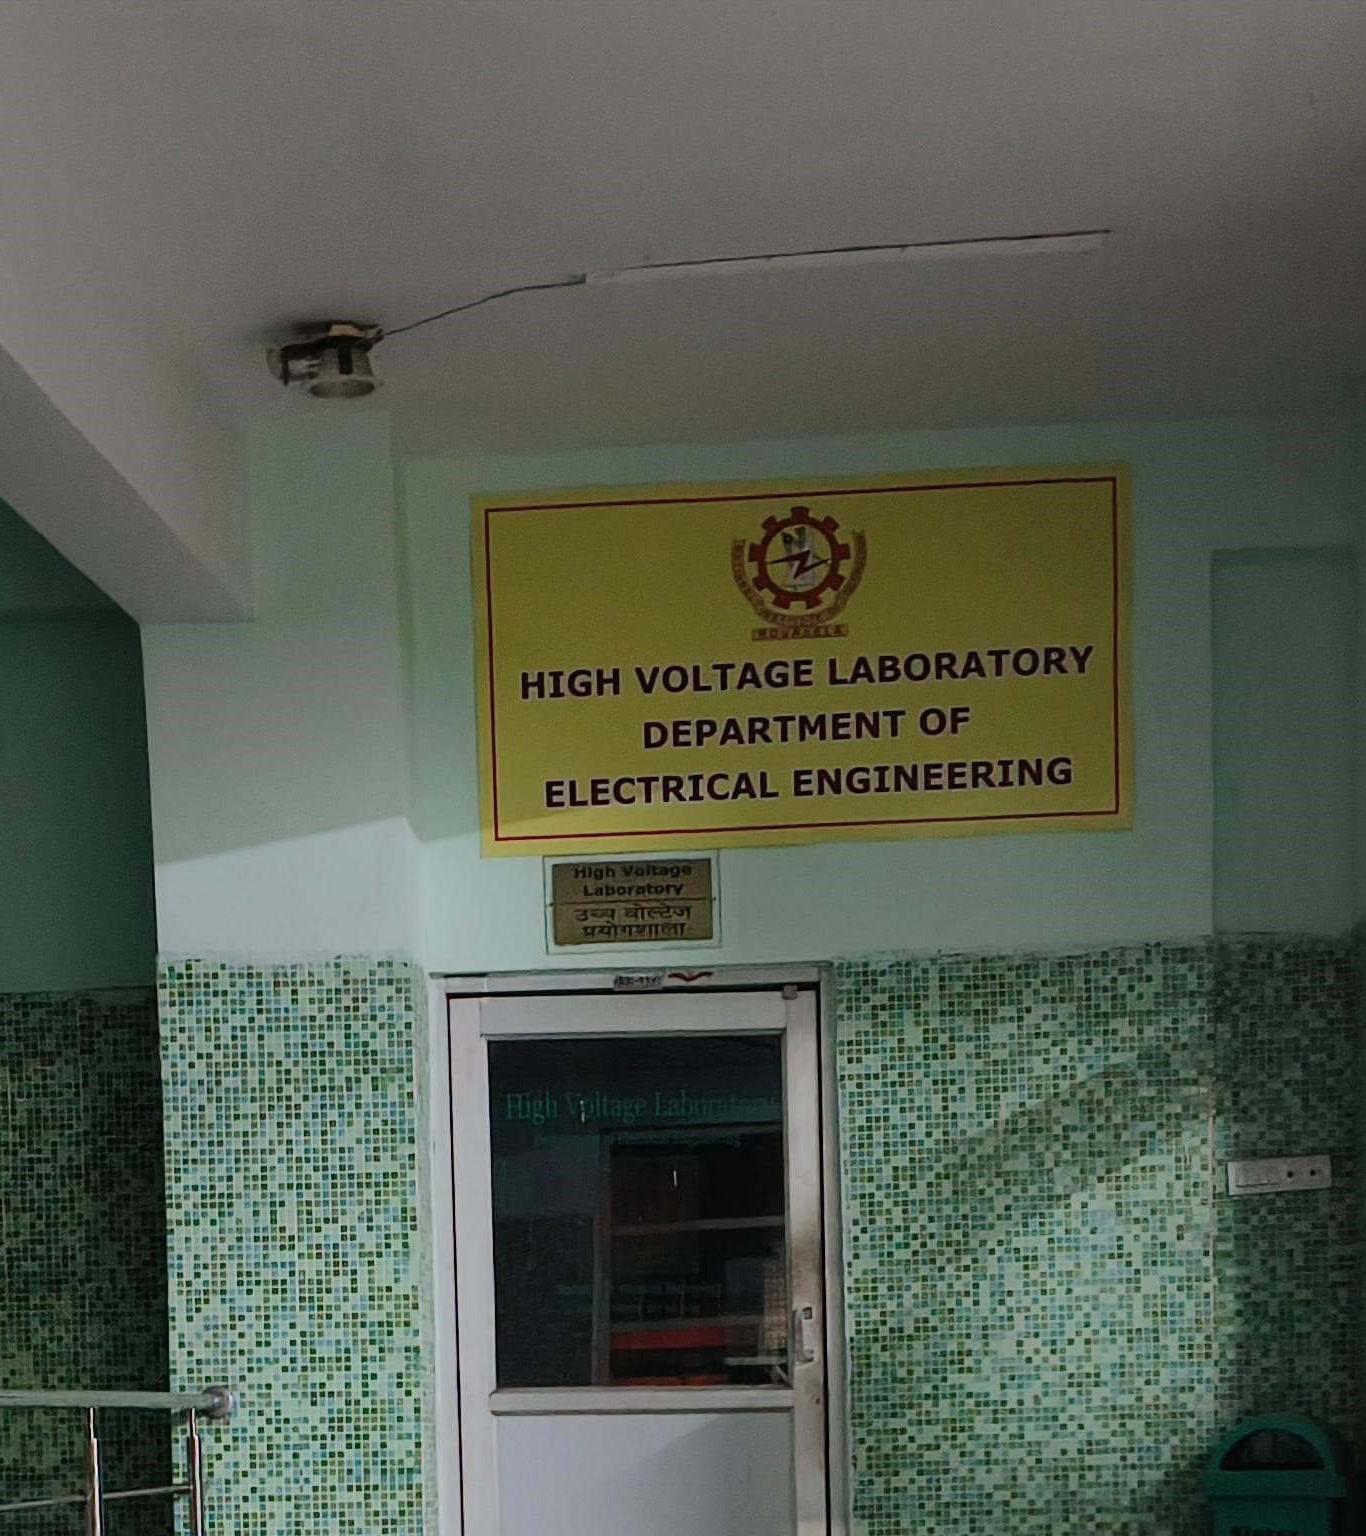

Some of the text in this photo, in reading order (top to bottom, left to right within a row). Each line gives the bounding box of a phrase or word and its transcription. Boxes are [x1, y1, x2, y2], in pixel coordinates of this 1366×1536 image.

[521, 645, 1094, 699] HIGH VOLTAGE LABORATORY
[643, 706, 971, 749] DEPARTMENT OF
[545, 756, 1073, 808] ELECTRICAL ENGINEERING
[574, 863, 692, 881] High Voltage
[583, 882, 684, 897] Laboratory
